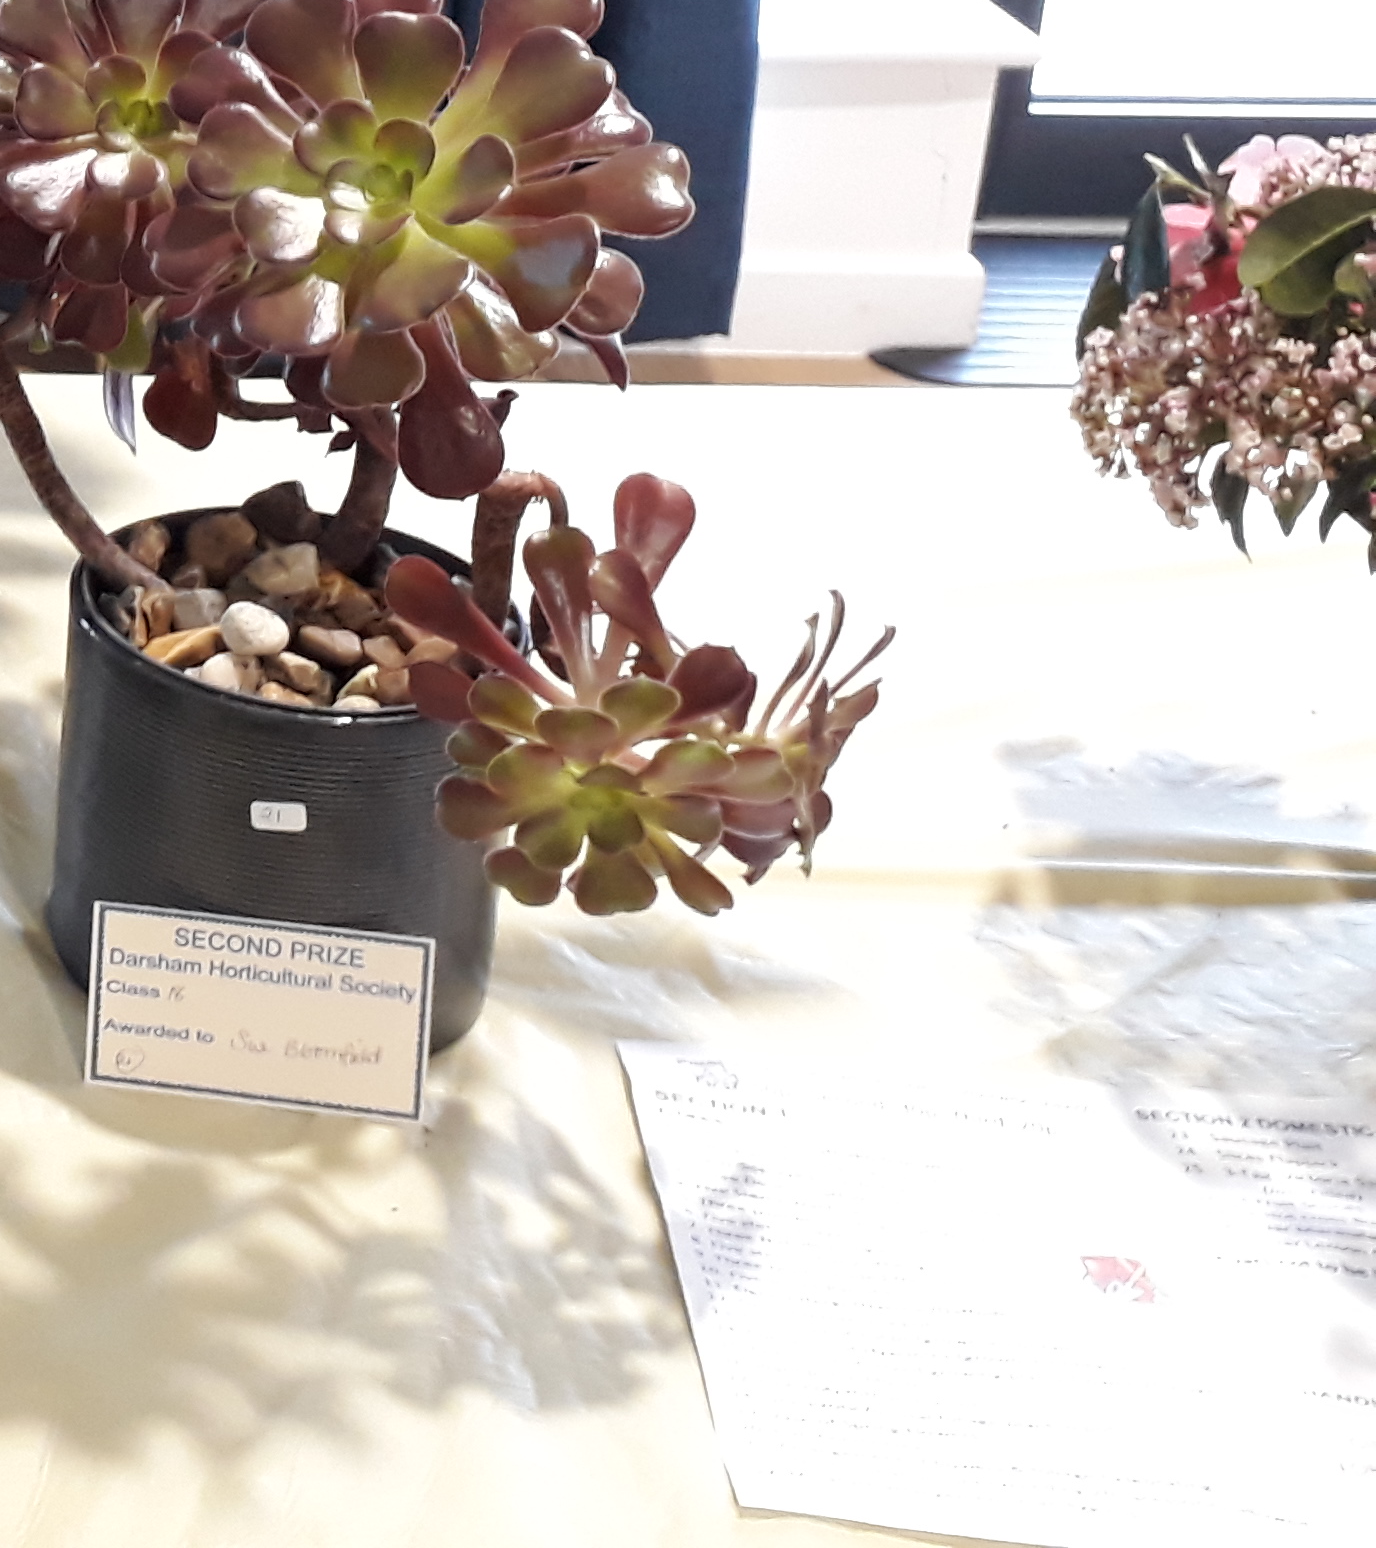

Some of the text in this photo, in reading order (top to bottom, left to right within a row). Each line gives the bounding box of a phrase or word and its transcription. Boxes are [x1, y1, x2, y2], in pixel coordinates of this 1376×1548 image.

[174, 927, 365, 968] SECOND PRIZE
[107, 980, 160, 998] Class
[109, 948, 416, 1003] Darsham Horticultural Society
[104, 1018, 188, 1041] Awarded
[196, 1029, 214, 1044] to
